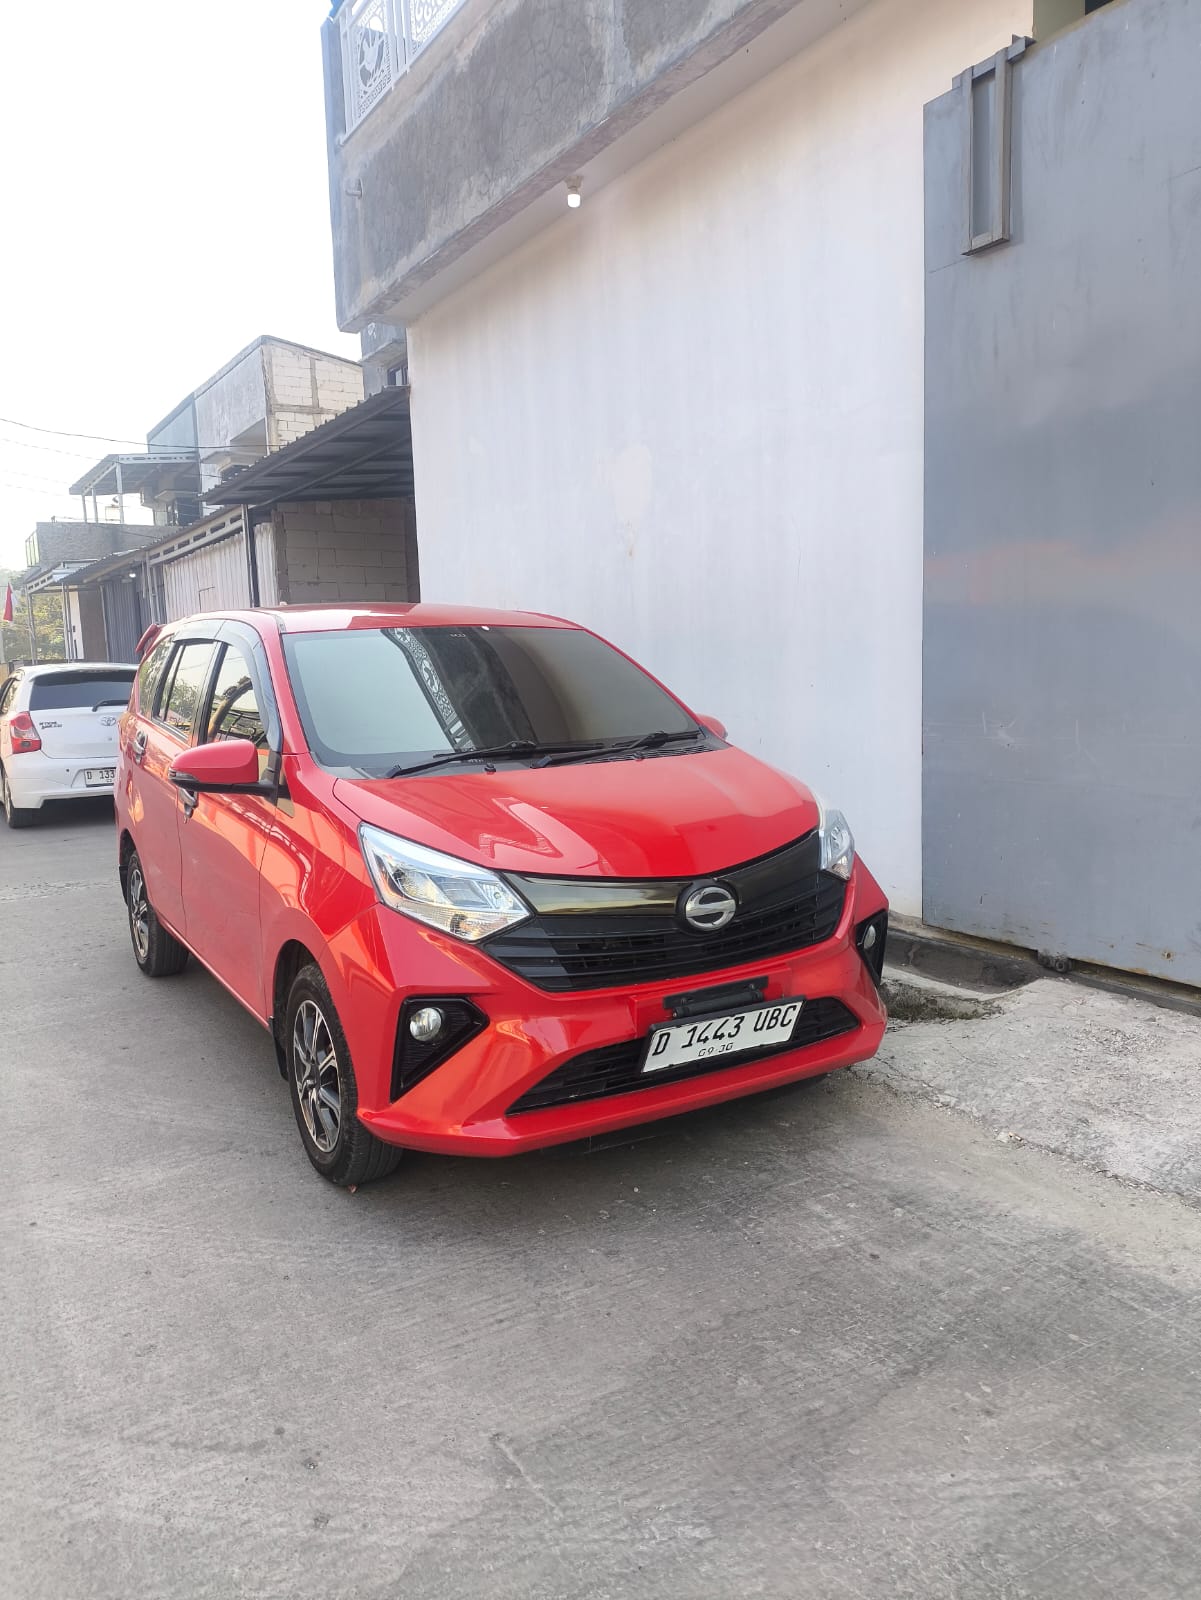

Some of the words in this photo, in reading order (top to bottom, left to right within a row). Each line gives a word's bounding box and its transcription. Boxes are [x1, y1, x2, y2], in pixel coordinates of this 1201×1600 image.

[651, 1031, 671, 1056] D
[680, 1015, 746, 1048] 1443
[753, 1004, 797, 1033] UBC
